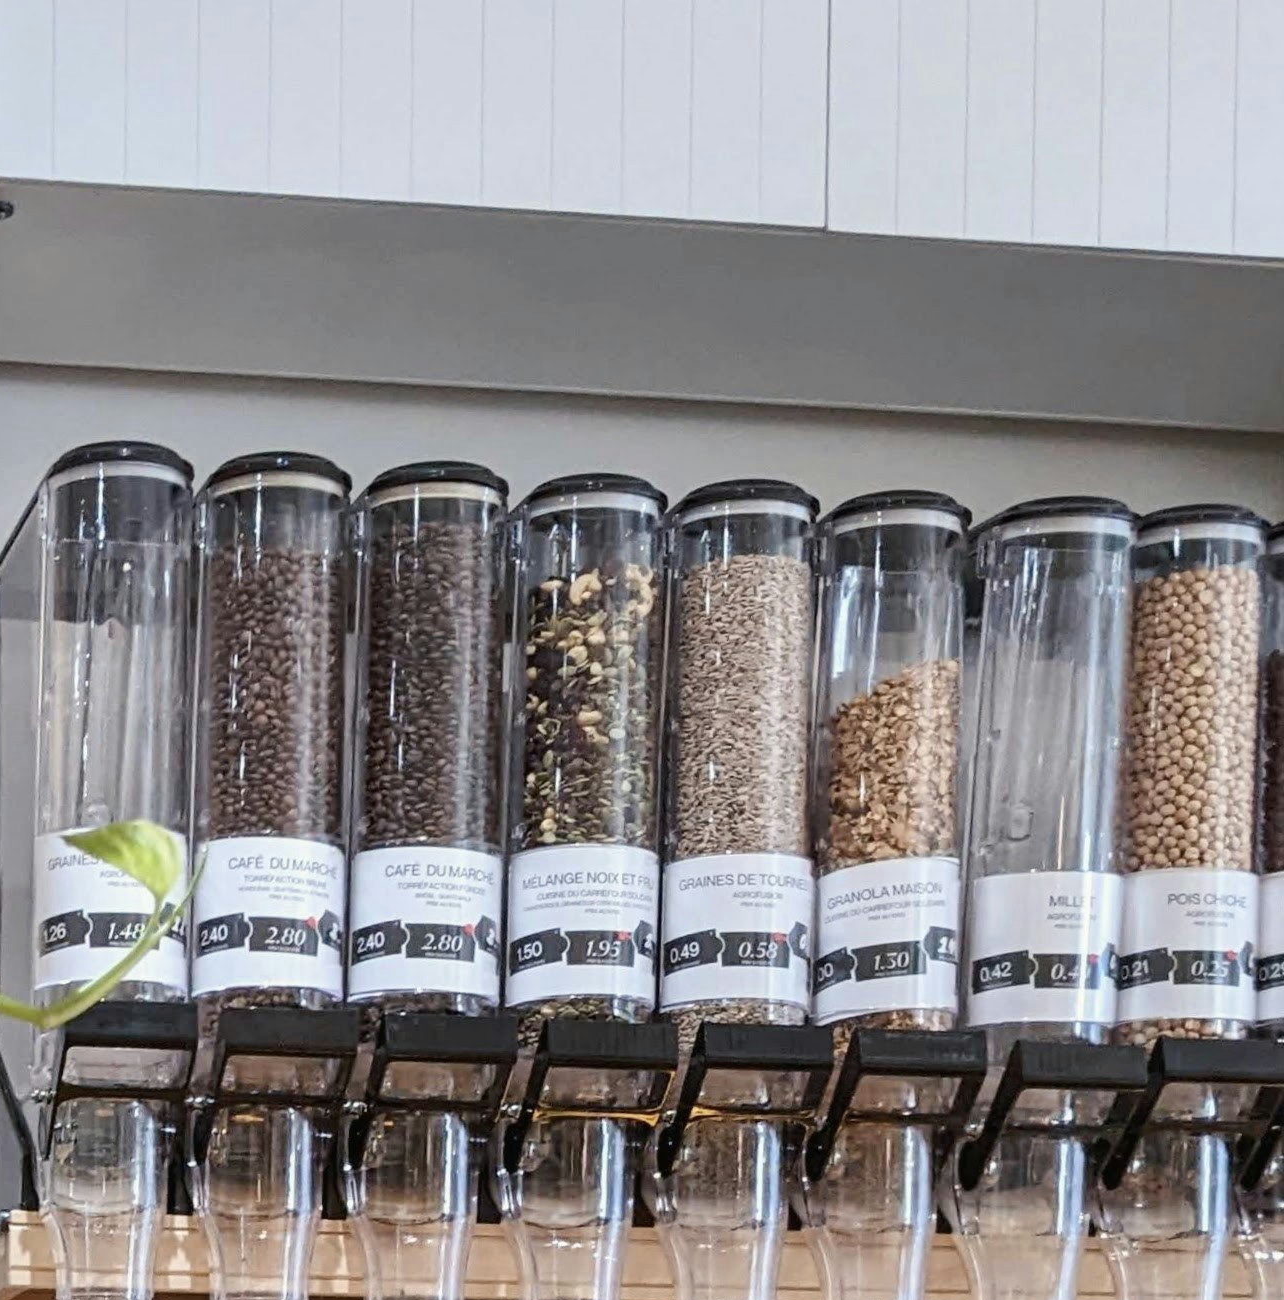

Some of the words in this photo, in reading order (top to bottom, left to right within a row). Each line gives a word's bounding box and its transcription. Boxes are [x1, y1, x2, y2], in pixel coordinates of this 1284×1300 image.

[228, 855, 264, 871] CAFÉ
[269, 857, 290, 870] DU
[426, 864, 446, 877] DU
[523, 871, 584, 889] MÉLANGE
[586, 872, 620, 885] NOIX
[622, 873, 636, 885] ET
[679, 874, 734, 891] GRAINES
[737, 874, 757, 885] DE
[827, 886, 890, 910] GRANOLA
[892, 882, 942, 896] MAISON
[1168, 893, 1201, 905] POIS
[264, 926, 306, 945] 2.80
[421, 933, 463, 952] 2.80
[670, 942, 700, 963] 0.49
[738, 942, 777, 959] 0.58
[874, 951, 910, 970] 1.30
[979, 961, 1012, 982] 0.42
